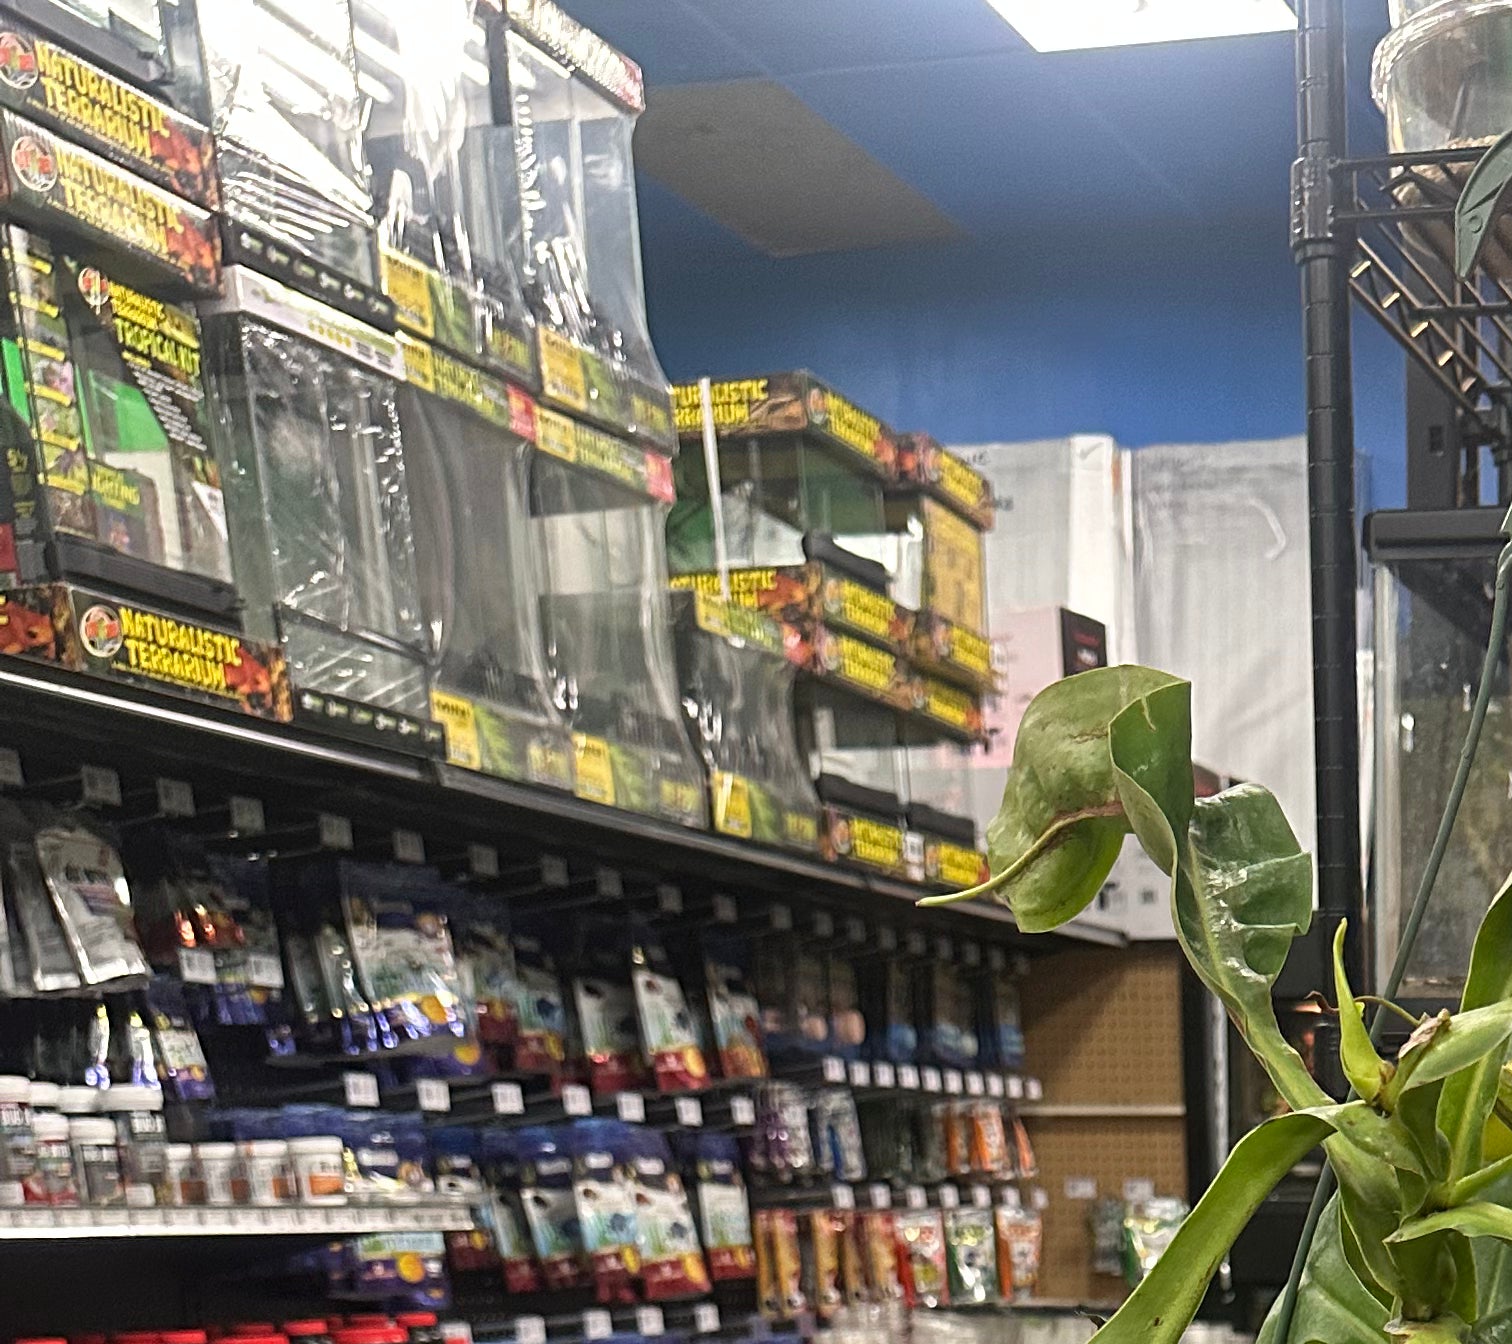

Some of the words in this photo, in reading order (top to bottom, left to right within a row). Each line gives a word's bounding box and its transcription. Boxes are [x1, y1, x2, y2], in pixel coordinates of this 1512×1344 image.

[34, 39, 170, 139] NATURALISTIC
[40, 76, 153, 159] TERRARIUM
[118, 606, 243, 667] NATURALISTIC
[124, 637, 226, 690] TERRARIUM
